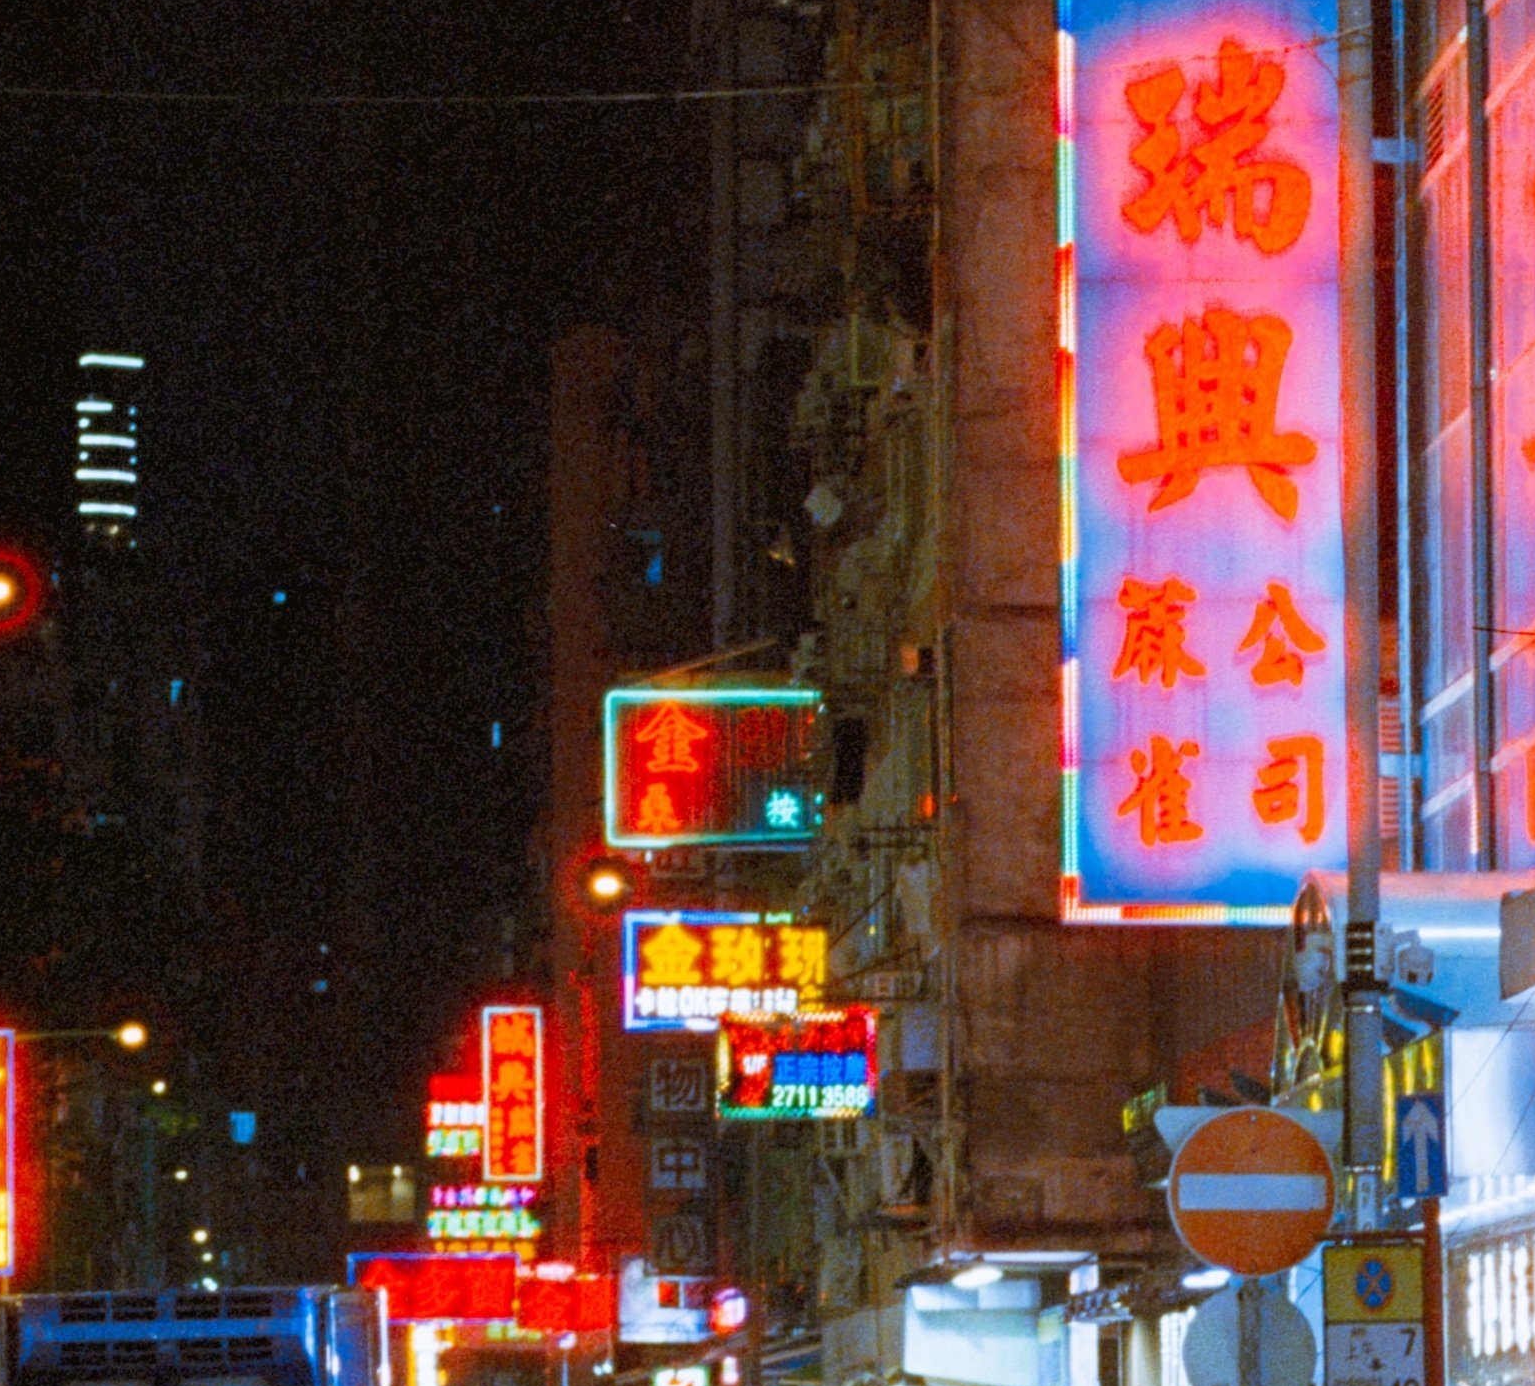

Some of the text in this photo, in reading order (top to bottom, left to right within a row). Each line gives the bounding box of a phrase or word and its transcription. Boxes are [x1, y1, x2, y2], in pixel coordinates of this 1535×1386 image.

[1117, 35, 1319, 526] 瑞興
[1236, 582, 1326, 846] 公司
[1400, 1328, 1416, 1356] 7
